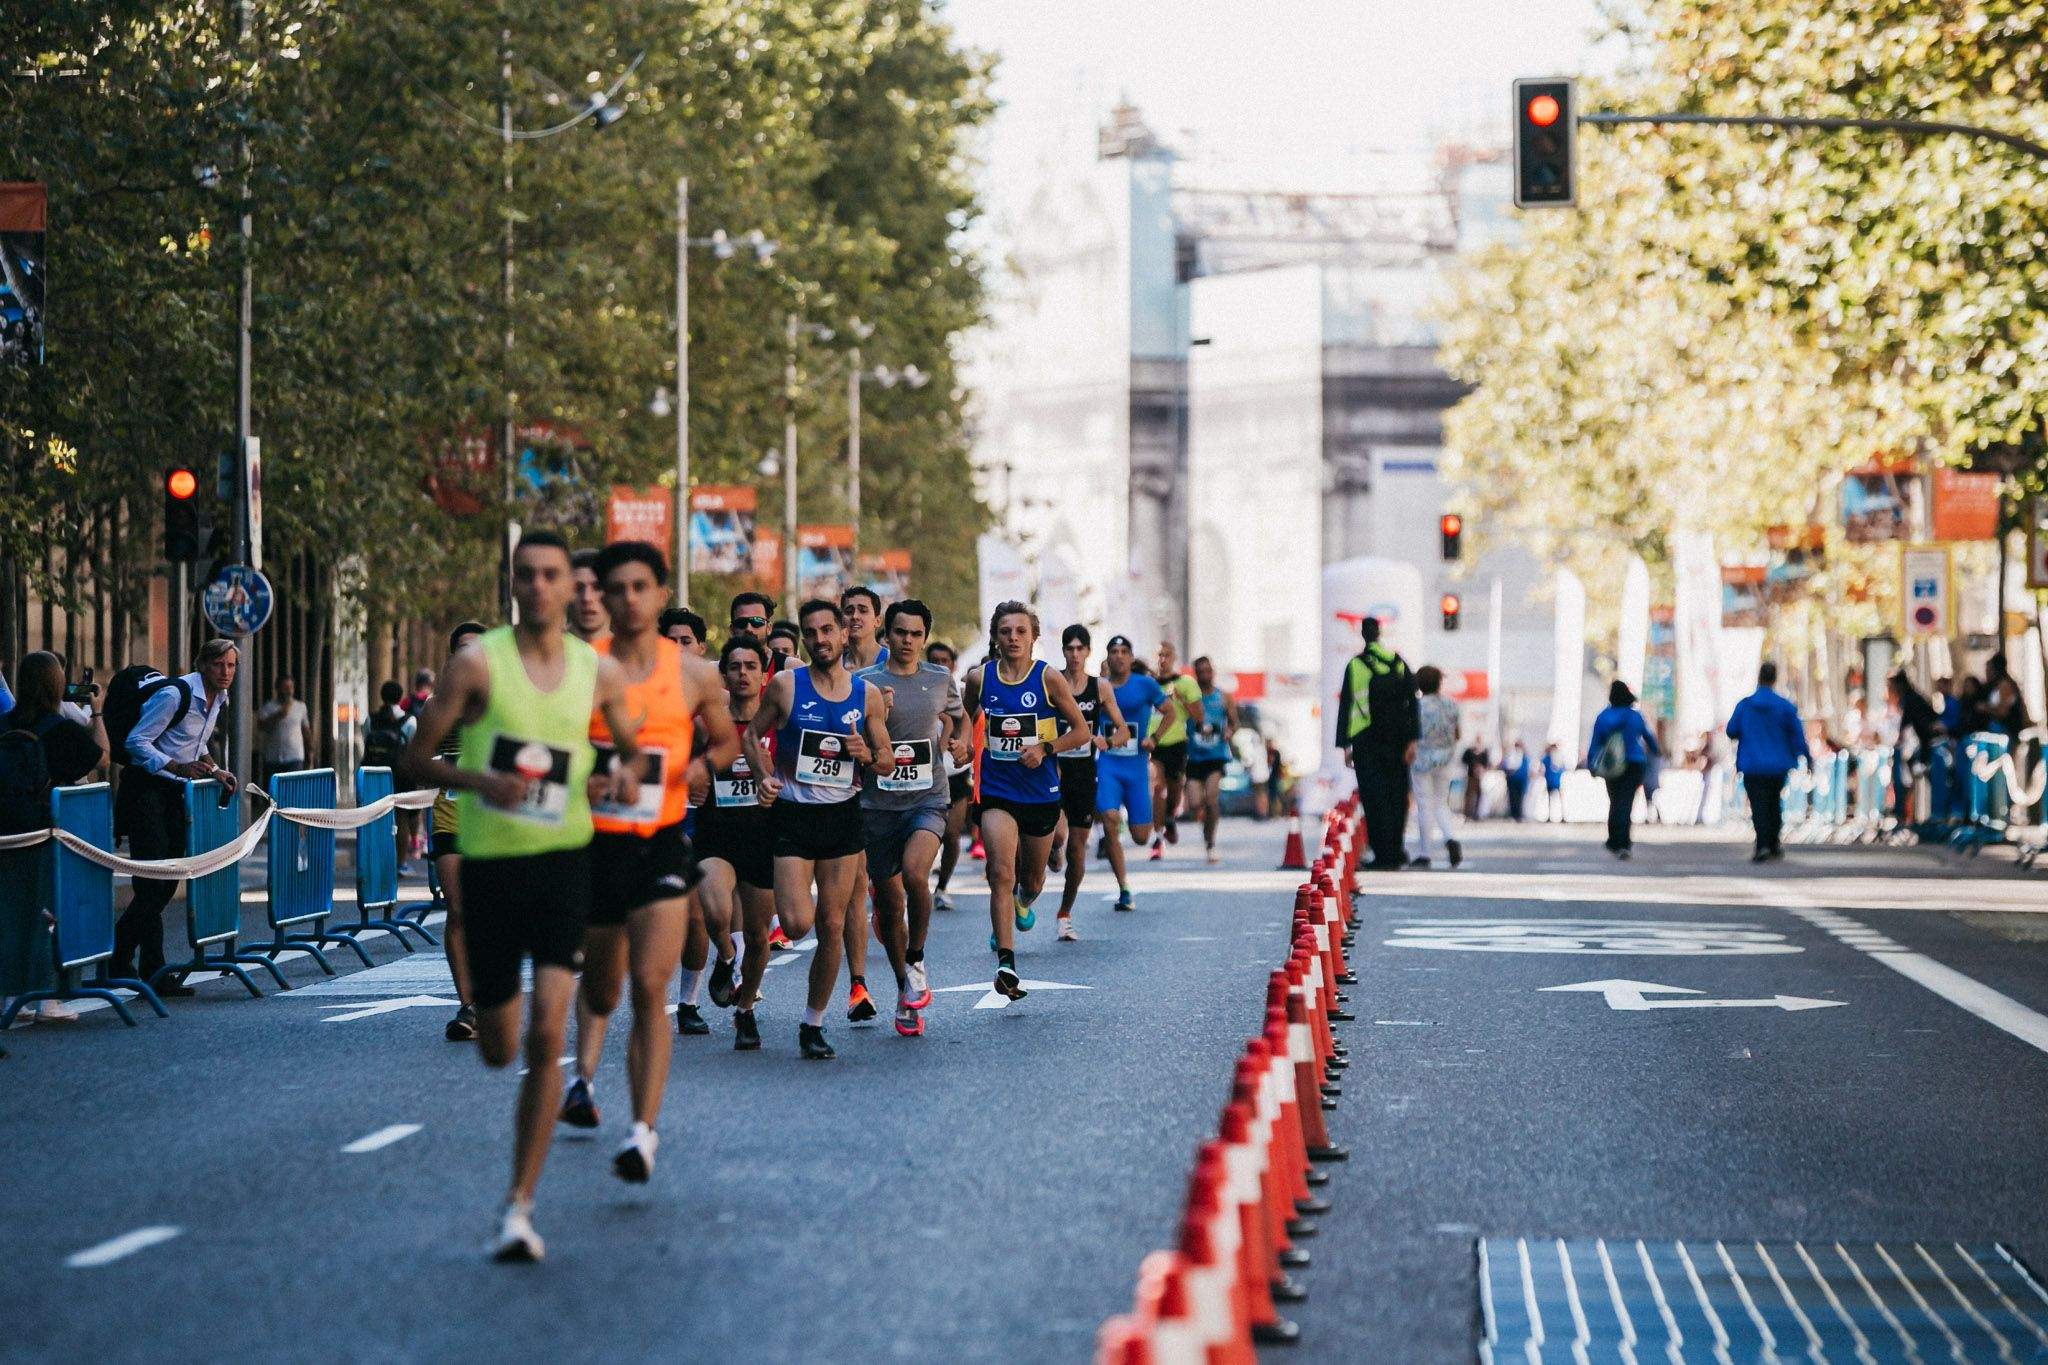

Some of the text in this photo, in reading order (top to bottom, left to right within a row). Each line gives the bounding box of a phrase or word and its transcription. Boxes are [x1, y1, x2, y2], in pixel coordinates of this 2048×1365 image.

[1000, 738, 1023, 751] 278
[813, 758, 842, 777] 259
[892, 766, 918, 781] 245
[731, 780, 756, 796] 281
